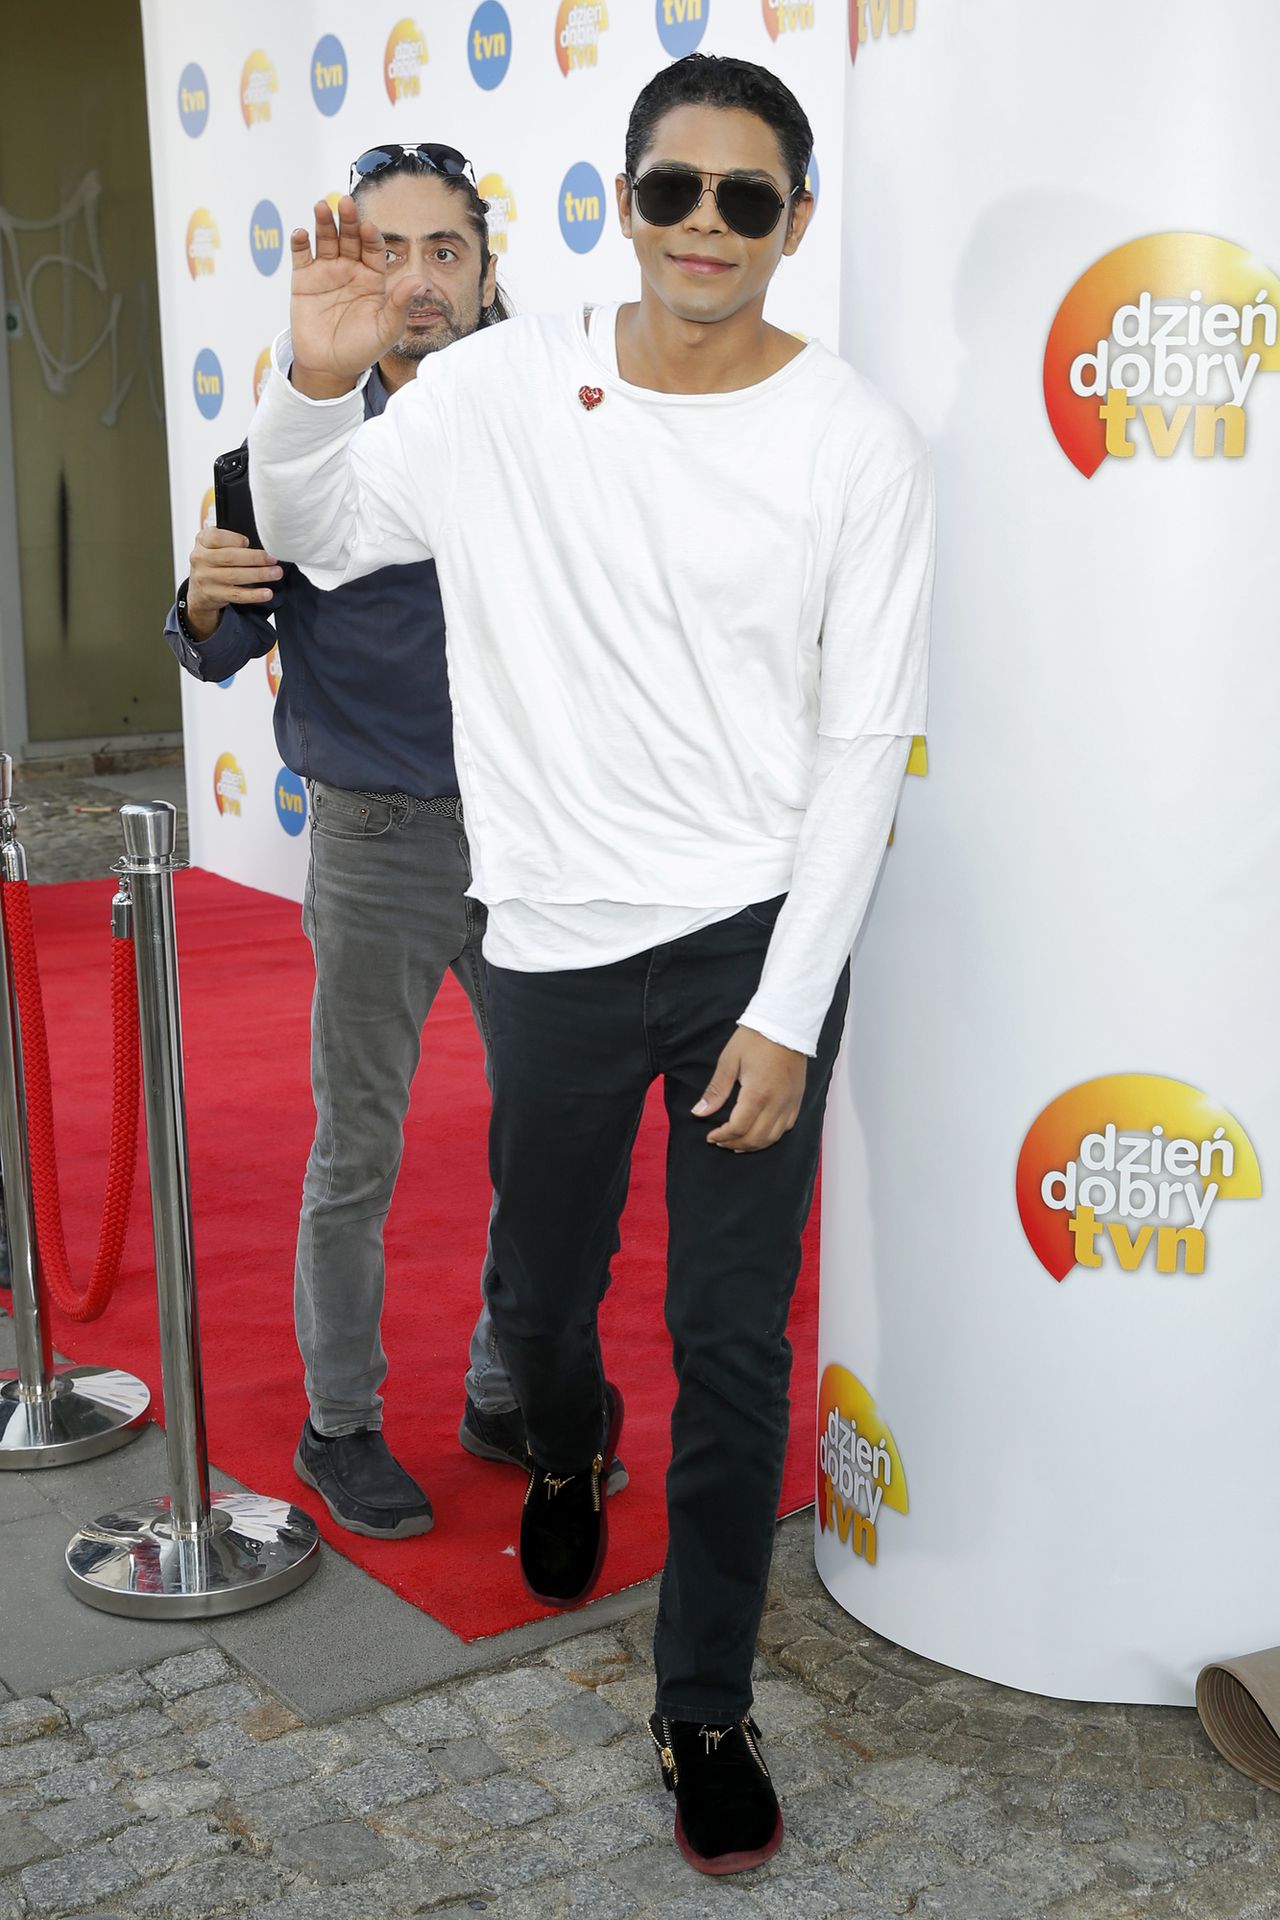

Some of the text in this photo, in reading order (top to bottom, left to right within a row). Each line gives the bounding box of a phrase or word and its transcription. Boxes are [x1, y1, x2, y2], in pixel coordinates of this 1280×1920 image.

[663, 0, 702, 25] tvn
[473, 29, 506, 61] tvn
[181, 87, 206, 112] tvn
[315, 62, 343, 89] tvn
[564, 191, 600, 223] tvn
[254, 223, 279, 250] tvn
[1111, 289, 1277, 347] dzień
[196, 370, 221, 395] tvn
[1069, 339, 1261, 408] dobry
[1099, 387, 1246, 458] tvn
[278, 784, 304, 814] tvn
[1080, 1123, 1235, 1177] dzień
[1041, 1161, 1219, 1231] dobry
[1068, 1204, 1206, 1274] tvn
[827, 1406, 891, 1486] dzień
[819, 1430, 883, 1525] dobry
[824, 1471, 878, 1566] tvn
